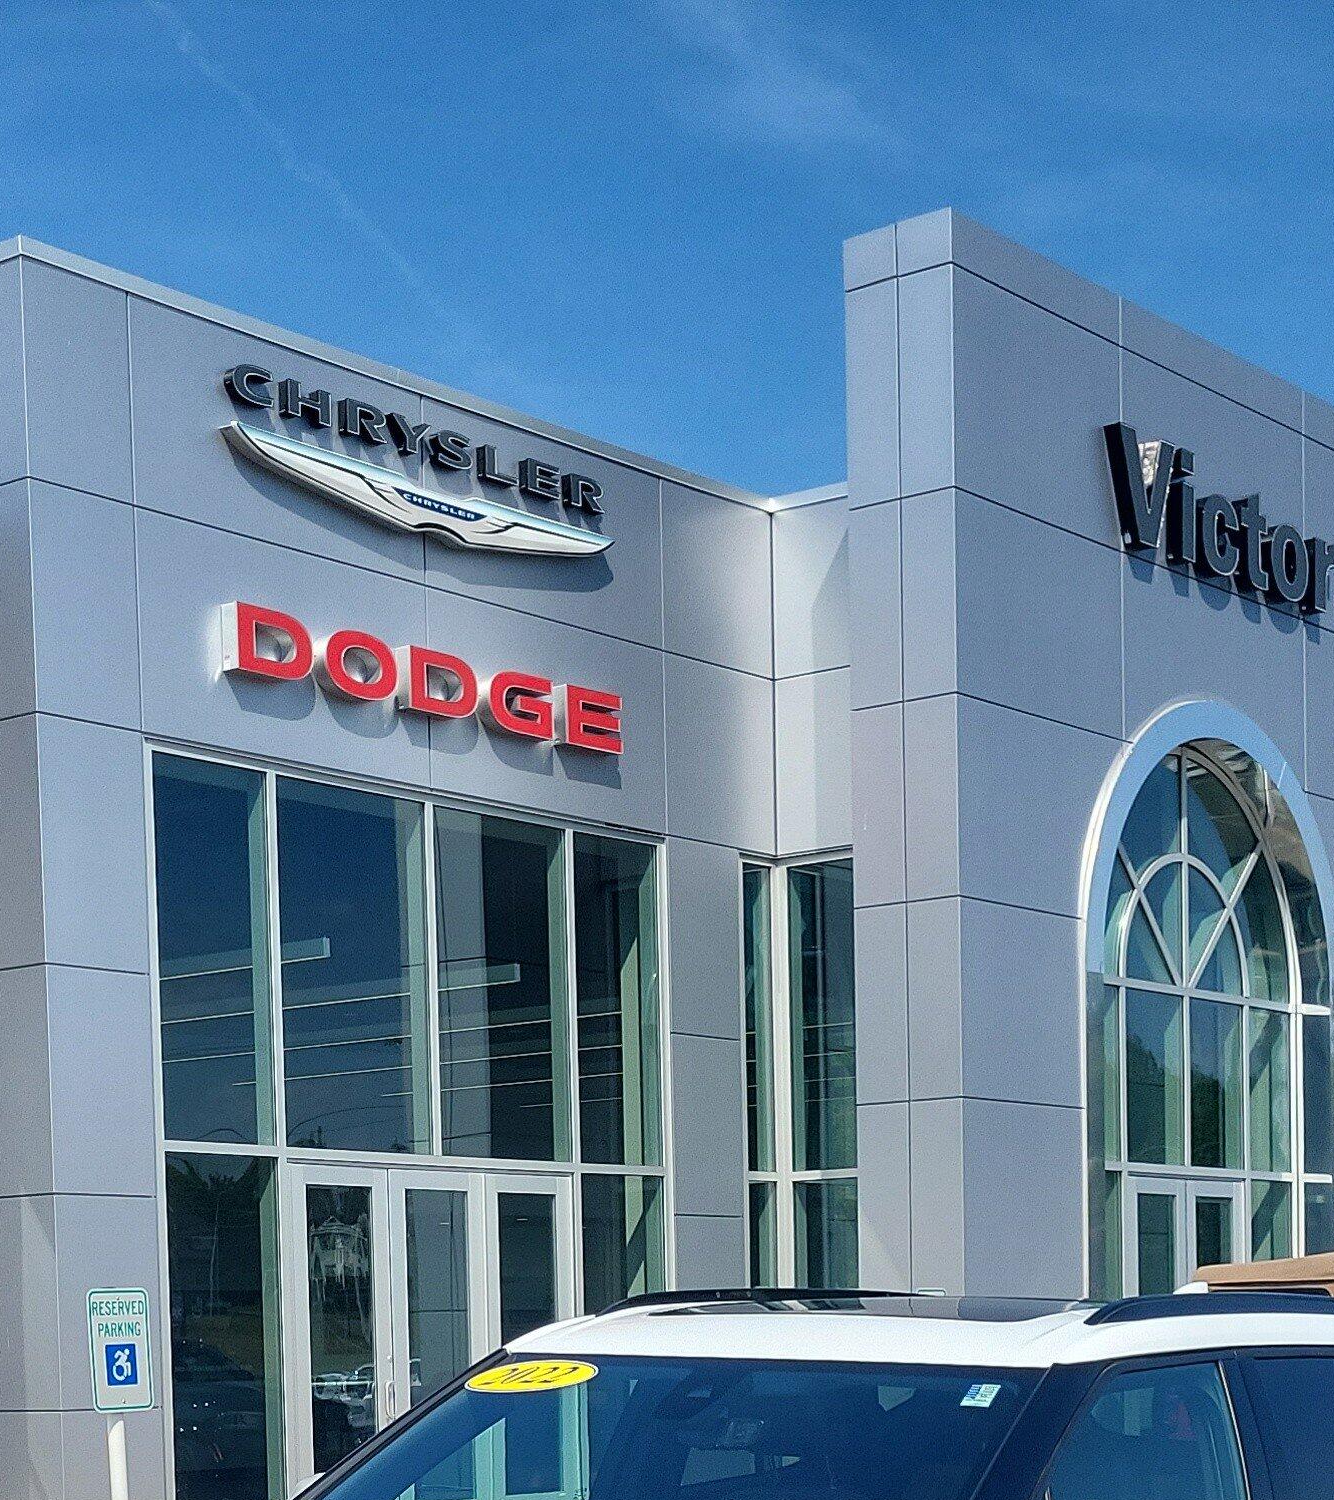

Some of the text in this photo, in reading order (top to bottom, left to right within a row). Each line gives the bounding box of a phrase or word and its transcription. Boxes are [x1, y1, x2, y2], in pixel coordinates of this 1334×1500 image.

[223, 364, 604, 513] CHRYSLER
[402, 493, 475, 519] CHRYSLER
[223, 600, 624, 754] DODGE
[91, 1300, 145, 1316] RESERVED
[97, 1322, 141, 1338] PARKING
[478, 1366, 580, 1386] 2022
